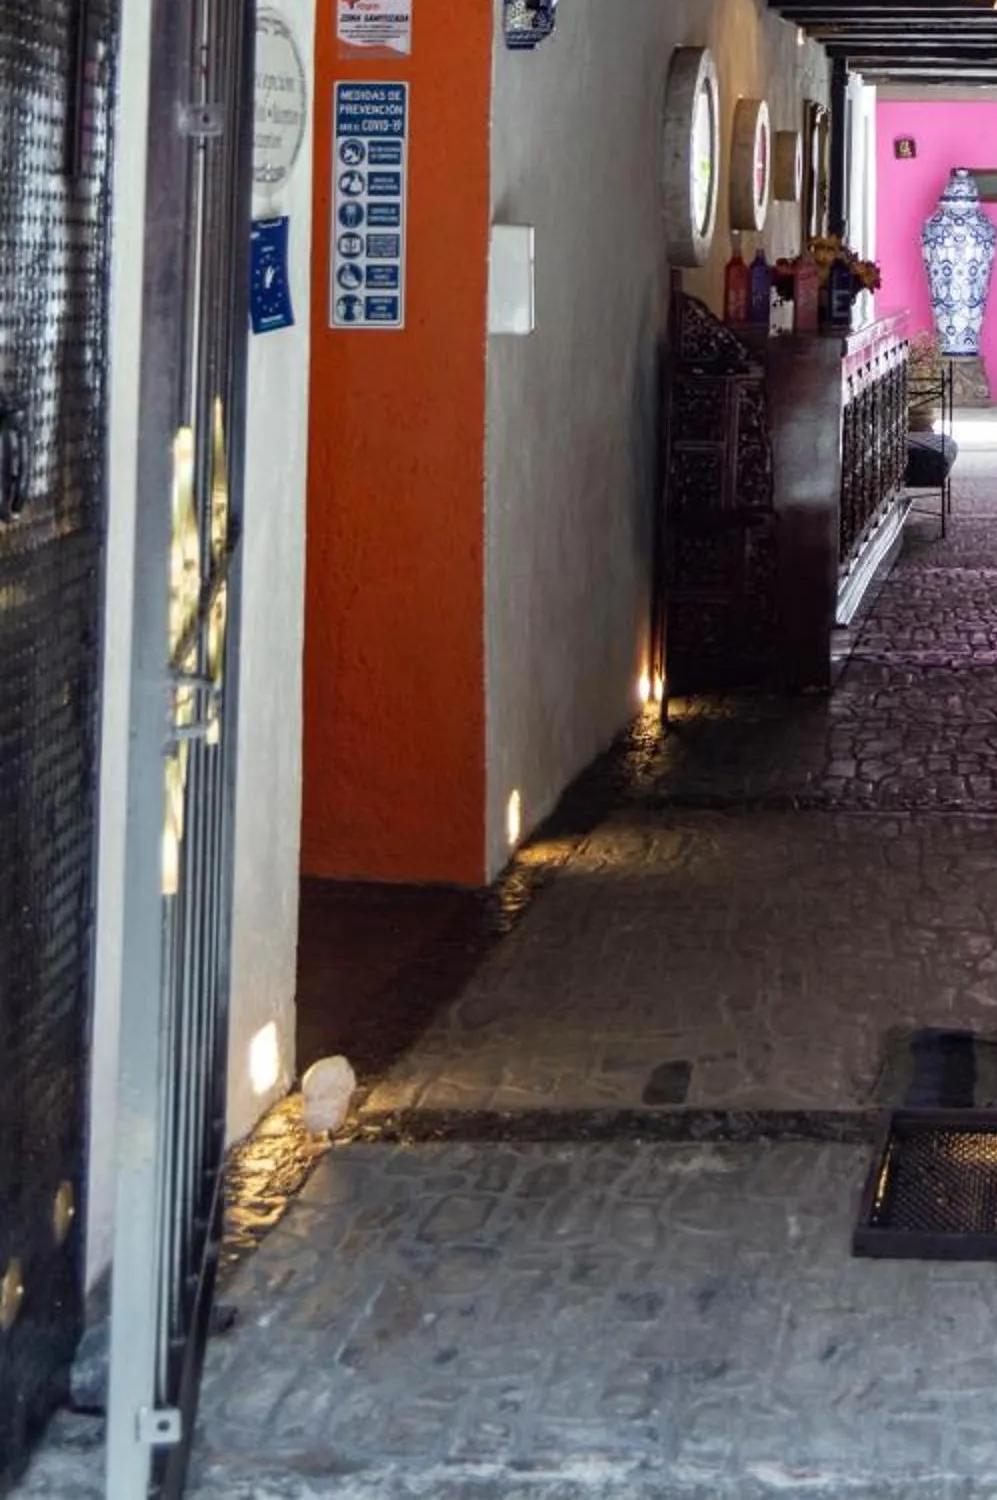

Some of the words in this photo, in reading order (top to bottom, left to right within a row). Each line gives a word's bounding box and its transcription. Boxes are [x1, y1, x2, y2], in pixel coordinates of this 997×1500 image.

[340, 89, 386, 101] MEDIDAS
[387, 90, 402, 101] DE
[339, 103, 403, 115] PREVENCIÓN
[361, 119, 402, 132] COVID-19
